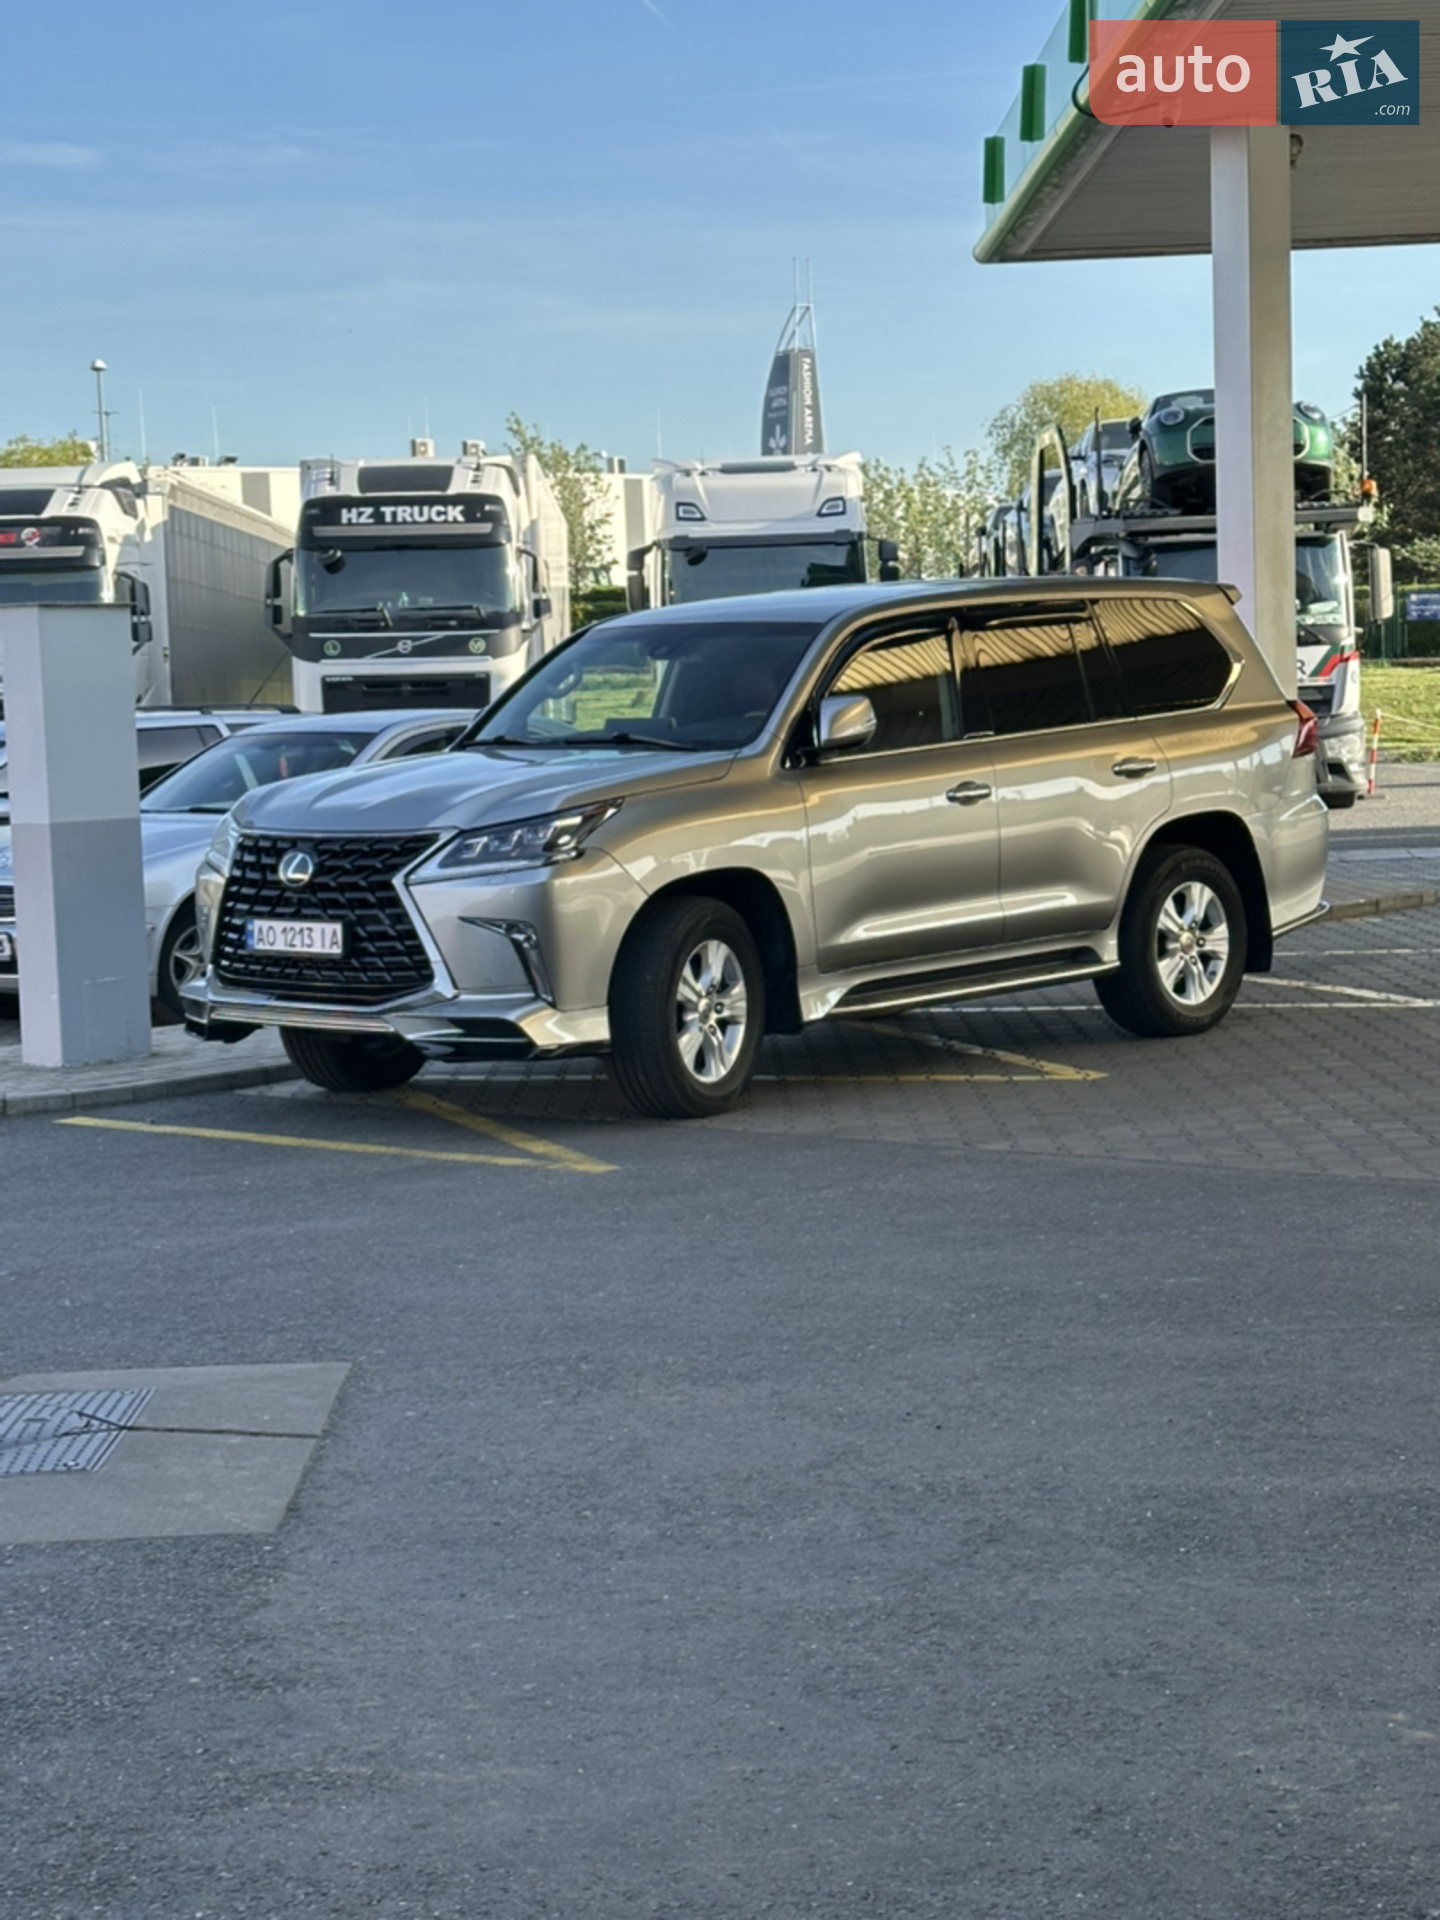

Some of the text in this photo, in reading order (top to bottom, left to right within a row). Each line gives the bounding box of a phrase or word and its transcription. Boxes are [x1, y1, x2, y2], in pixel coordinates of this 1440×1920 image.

[802, 358, 814, 446] FASHION ARENA
[341, 505, 466, 524] HZ TRUCK
[256, 925, 341, 950] AO 1213 IA
